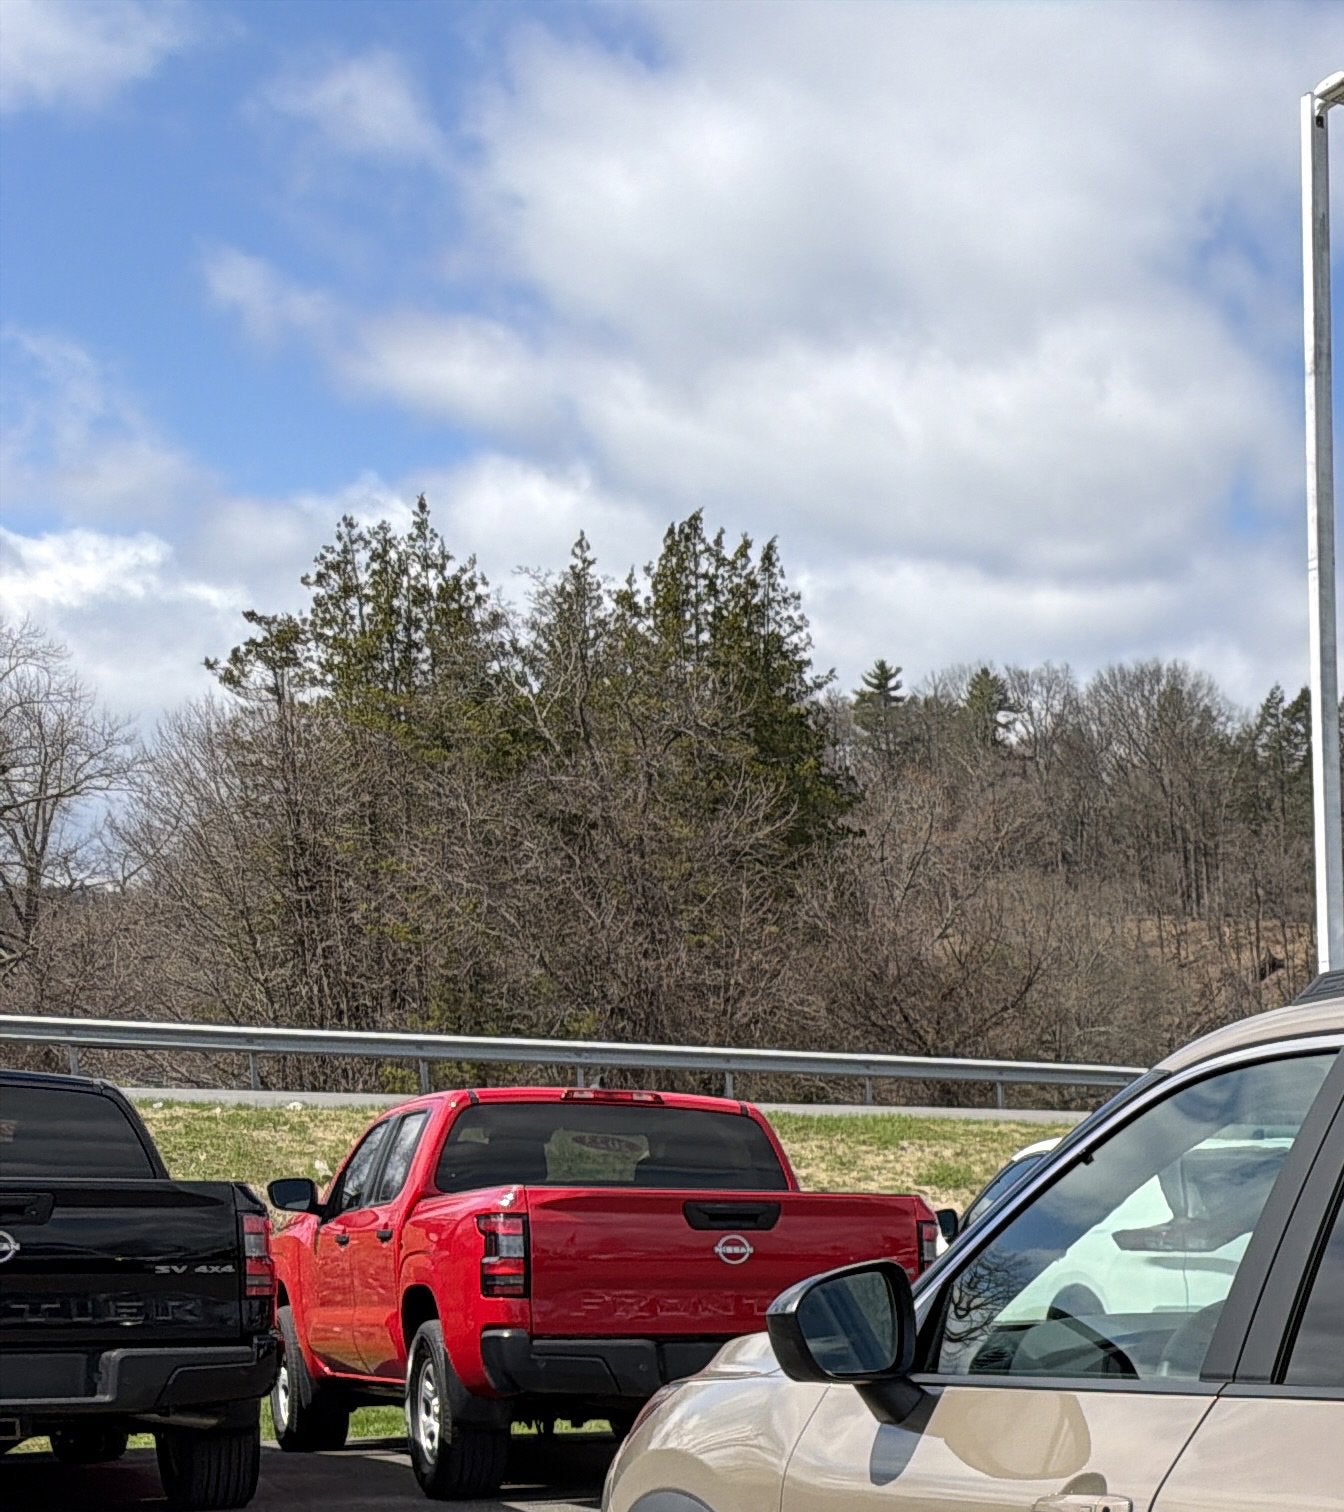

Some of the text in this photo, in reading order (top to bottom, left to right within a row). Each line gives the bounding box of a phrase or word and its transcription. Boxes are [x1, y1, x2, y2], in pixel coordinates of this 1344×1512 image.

[155, 1264, 236, 1274] SV 4x4
[9, 1301, 198, 1322] TIER
